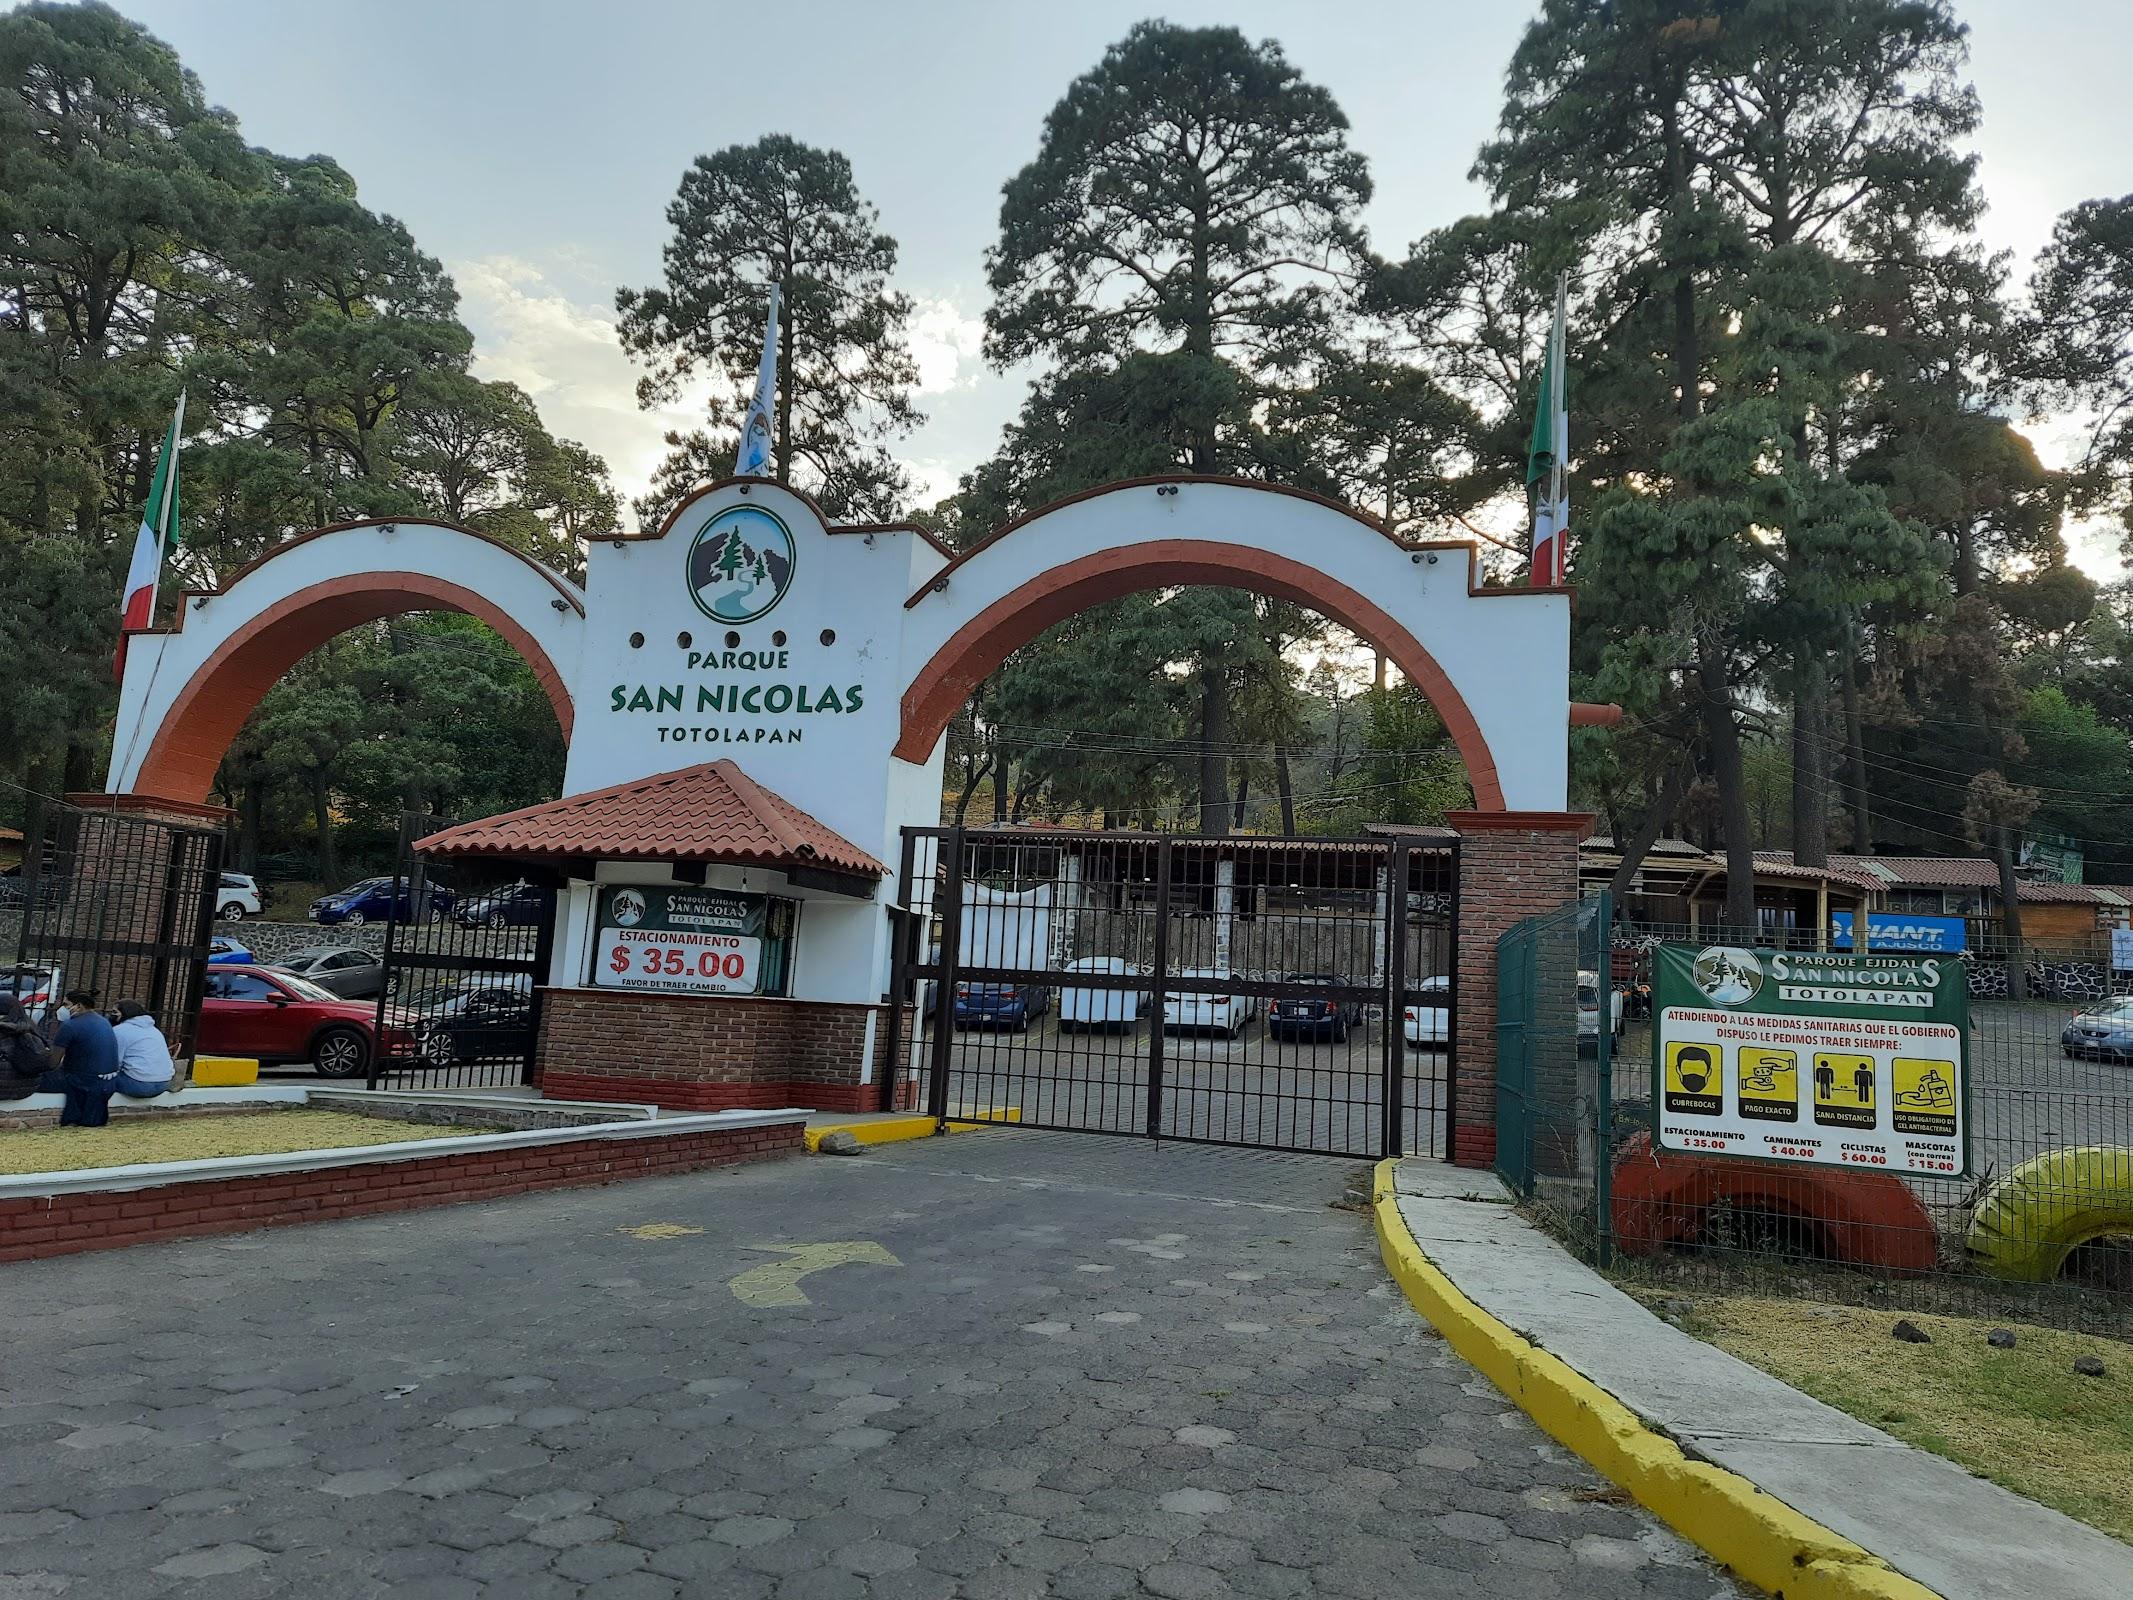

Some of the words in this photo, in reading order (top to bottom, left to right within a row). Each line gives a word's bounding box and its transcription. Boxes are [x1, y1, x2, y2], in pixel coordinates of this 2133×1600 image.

[687, 650, 789, 671] PARQUE
[611, 684, 684, 713] SAN
[697, 684, 863, 714] NICOLAS
[657, 727, 802, 743] TOTOLAPAN
[667, 895, 690, 913] SAN
[694, 901, 747, 917] NICOLAS
[678, 895, 707, 904] PARQUE
[711, 898, 738, 906] EJIDAL
[671, 915, 742, 927] TOTOLAPAN
[619, 930, 740, 948] ESTACIONAMIENTO
[1876, 941, 1942, 951] AJUSCO
[610, 945, 631, 974] $
[642, 948, 745, 979] 35.00
[1795, 956, 1856, 967] PARQUE
[1866, 958, 1919, 969] EJIDAL
[1771, 954, 1822, 981] SAN
[1832, 958, 1941, 988] NICOLAS
[622, 978, 648, 987] FAVOR
[651, 980, 660, 988] DE
[662, 981, 687, 989] TRAER
[690, 982, 726, 992] CAMBIO
[1785, 988, 1928, 1005] TOTOLAPAN
[1668, 1010, 1727, 1024] ATENDIENDO
[1729, 1015, 1737, 1024] A
[1738, 1016, 1755, 1027] LAS
[1757, 1017, 1801, 1029] MEDIDAS
[1804, 1020, 1862, 1033] SANITARIAS
[1864, 1023, 1886, 1035] QUE
[1888, 1025, 1900, 1035] EL
[1902, 1026, 1956, 1039] GOBIERNO
[1717, 1028, 1758, 1041] DISPUSO
[1760, 1032, 1771, 1042] LE
[1773, 1033, 1818, 1045] PEDIMOS
[1820, 1036, 1851, 1047] TRAER
[1854, 1038, 1902, 1050] SIEMPRE:
[1671, 1098, 1716, 1109] CUBREBOCAS
[1744, 1104, 1764, 1113] PAGO
[1765, 1106, 1792, 1115] EXACTO
[1816, 1111, 1836, 1120] SANA
[1837, 1113, 1875, 1123] DISTANCIA
[1894, 1114, 1906, 1122] USO
[1664, 1127, 1745, 1141] ESTACIONAMIENTO
[1693, 1139, 1726, 1149] 35.00
[1763, 1135, 1822, 1147] CAMINANTES
[1905, 1141, 1956, 1153] MASCOTAS
[1780, 1146, 1815, 1158] 40.00
[1840, 1143, 1886, 1154] CICLISTAS
[1851, 1153, 1887, 1164] 60.00
[1907, 1150, 1925, 1159] (con
[1926, 1152, 1954, 1162] correa)
[1919, 1160, 1954, 1171] 15.00
